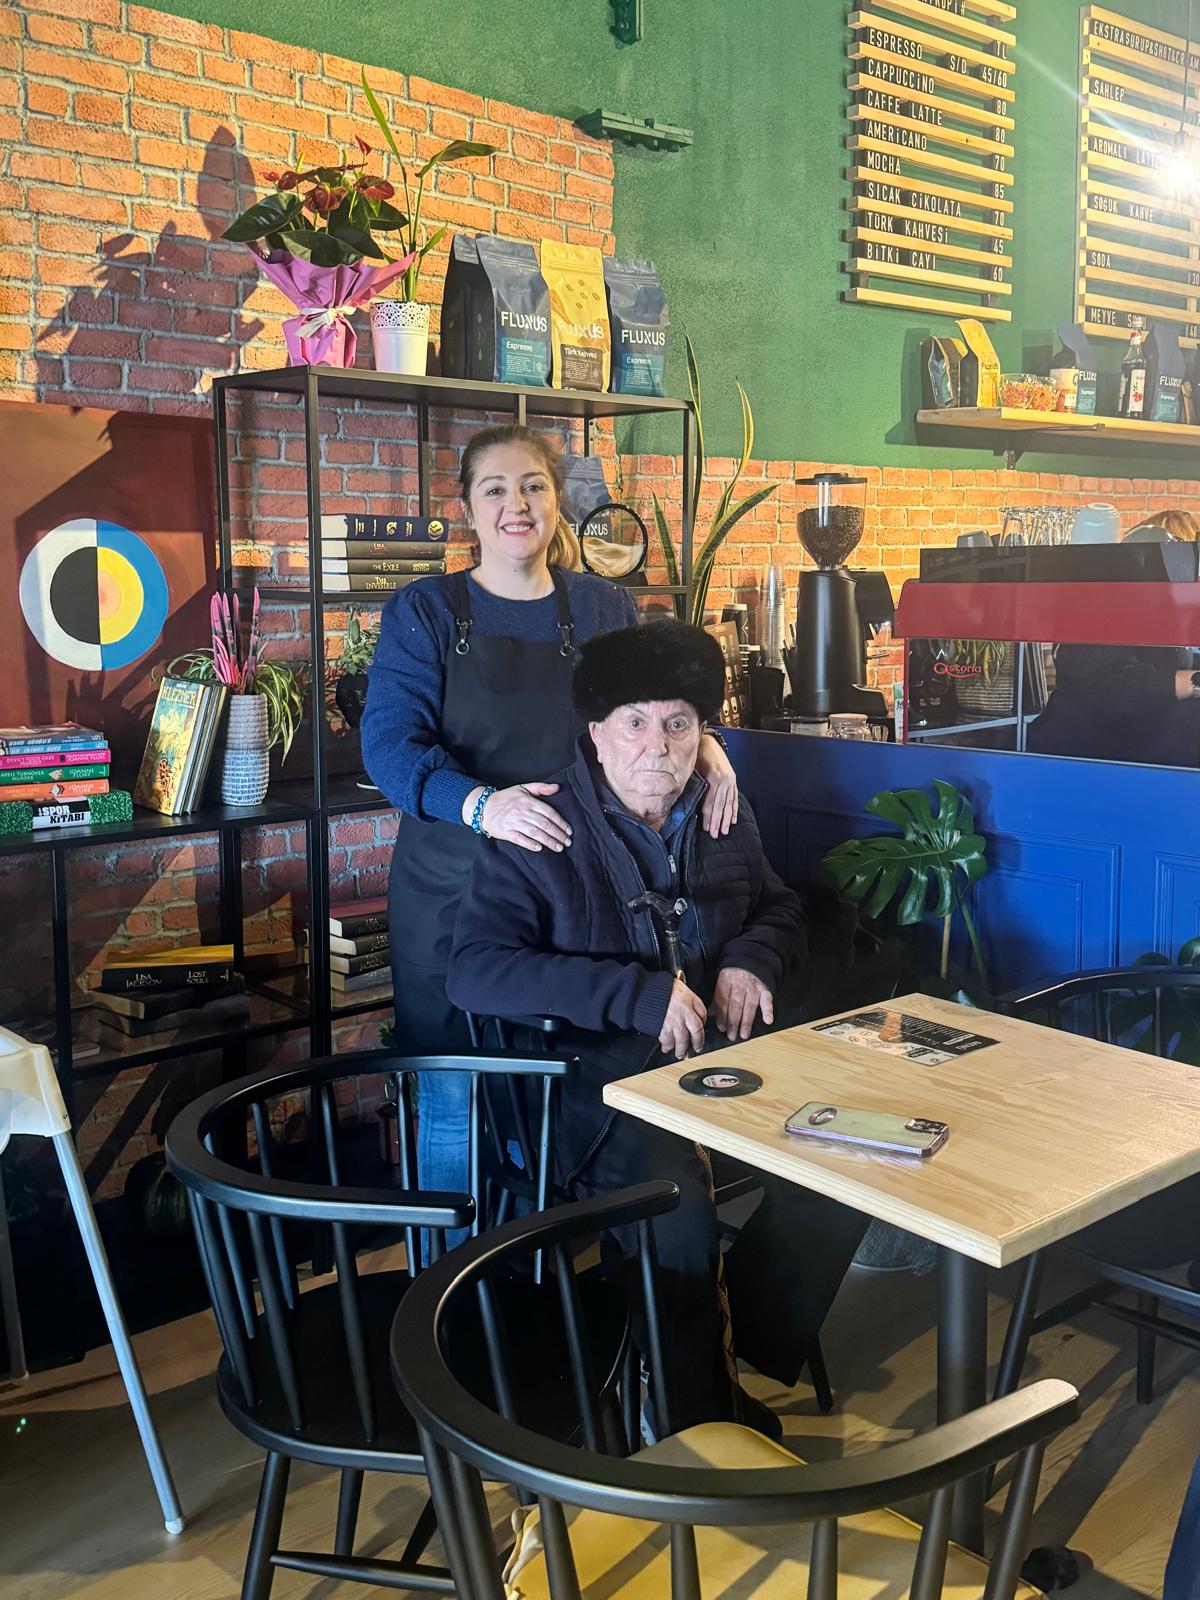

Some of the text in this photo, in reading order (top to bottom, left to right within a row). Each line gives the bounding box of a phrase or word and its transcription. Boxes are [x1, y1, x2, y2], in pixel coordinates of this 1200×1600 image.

[869, 28, 1008, 88] ESPRESSO S/D 45/60
[996, 40, 1007, 59] TL
[1094, 79, 1125, 102] SAHLEP
[867, 90, 1006, 144] CAFFE LATTE 80
[996, 99, 1007, 116] 80
[994, 155, 1005, 171] 70
[867, 151, 1005, 199] MOCHA 85
[868, 182, 901, 205] SICAK
[994, 210, 1005, 226] 70
[1129, 201, 1154, 222] KAHVE
[993, 239, 1004, 255] 45
[1091, 251, 1111, 269] SODA
[993, 267, 1003, 282] 60
[501, 310, 548, 332] FLUXUS
[556, 320, 605, 340] FLUXUS
[506, 341, 533, 352] Espresso
[621, 329, 666, 346] FLUXUS
